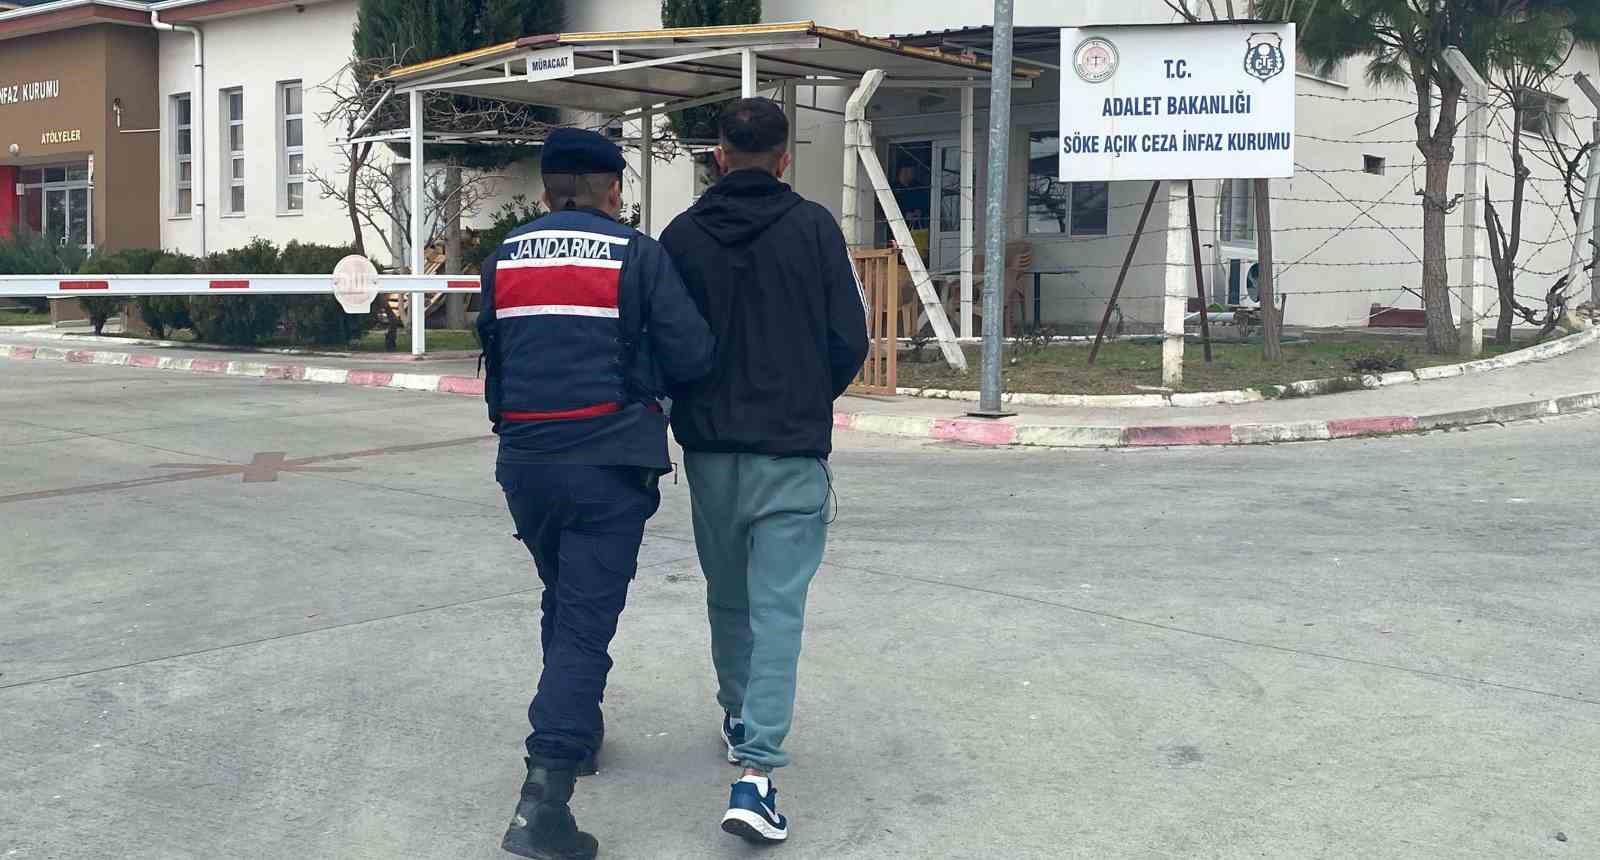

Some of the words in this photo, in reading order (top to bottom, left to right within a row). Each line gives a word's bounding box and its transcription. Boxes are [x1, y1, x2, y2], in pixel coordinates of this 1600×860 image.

[532, 57, 568, 71] MÜRACAAT
[1163, 59, 1192, 79] T.C.
[22, 80, 59, 101] KURUMU
[1102, 96, 1162, 117] ADALET
[1167, 89, 1252, 115] BAKANLIĞI
[1063, 131, 1100, 154] SÖKE
[1104, 134, 1138, 158] AÇIK
[1141, 134, 1178, 153] CEZA
[1182, 129, 1223, 152] İNFAZ
[1227, 132, 1291, 151] KURUMU
[510, 238, 612, 260] JANDARMA
